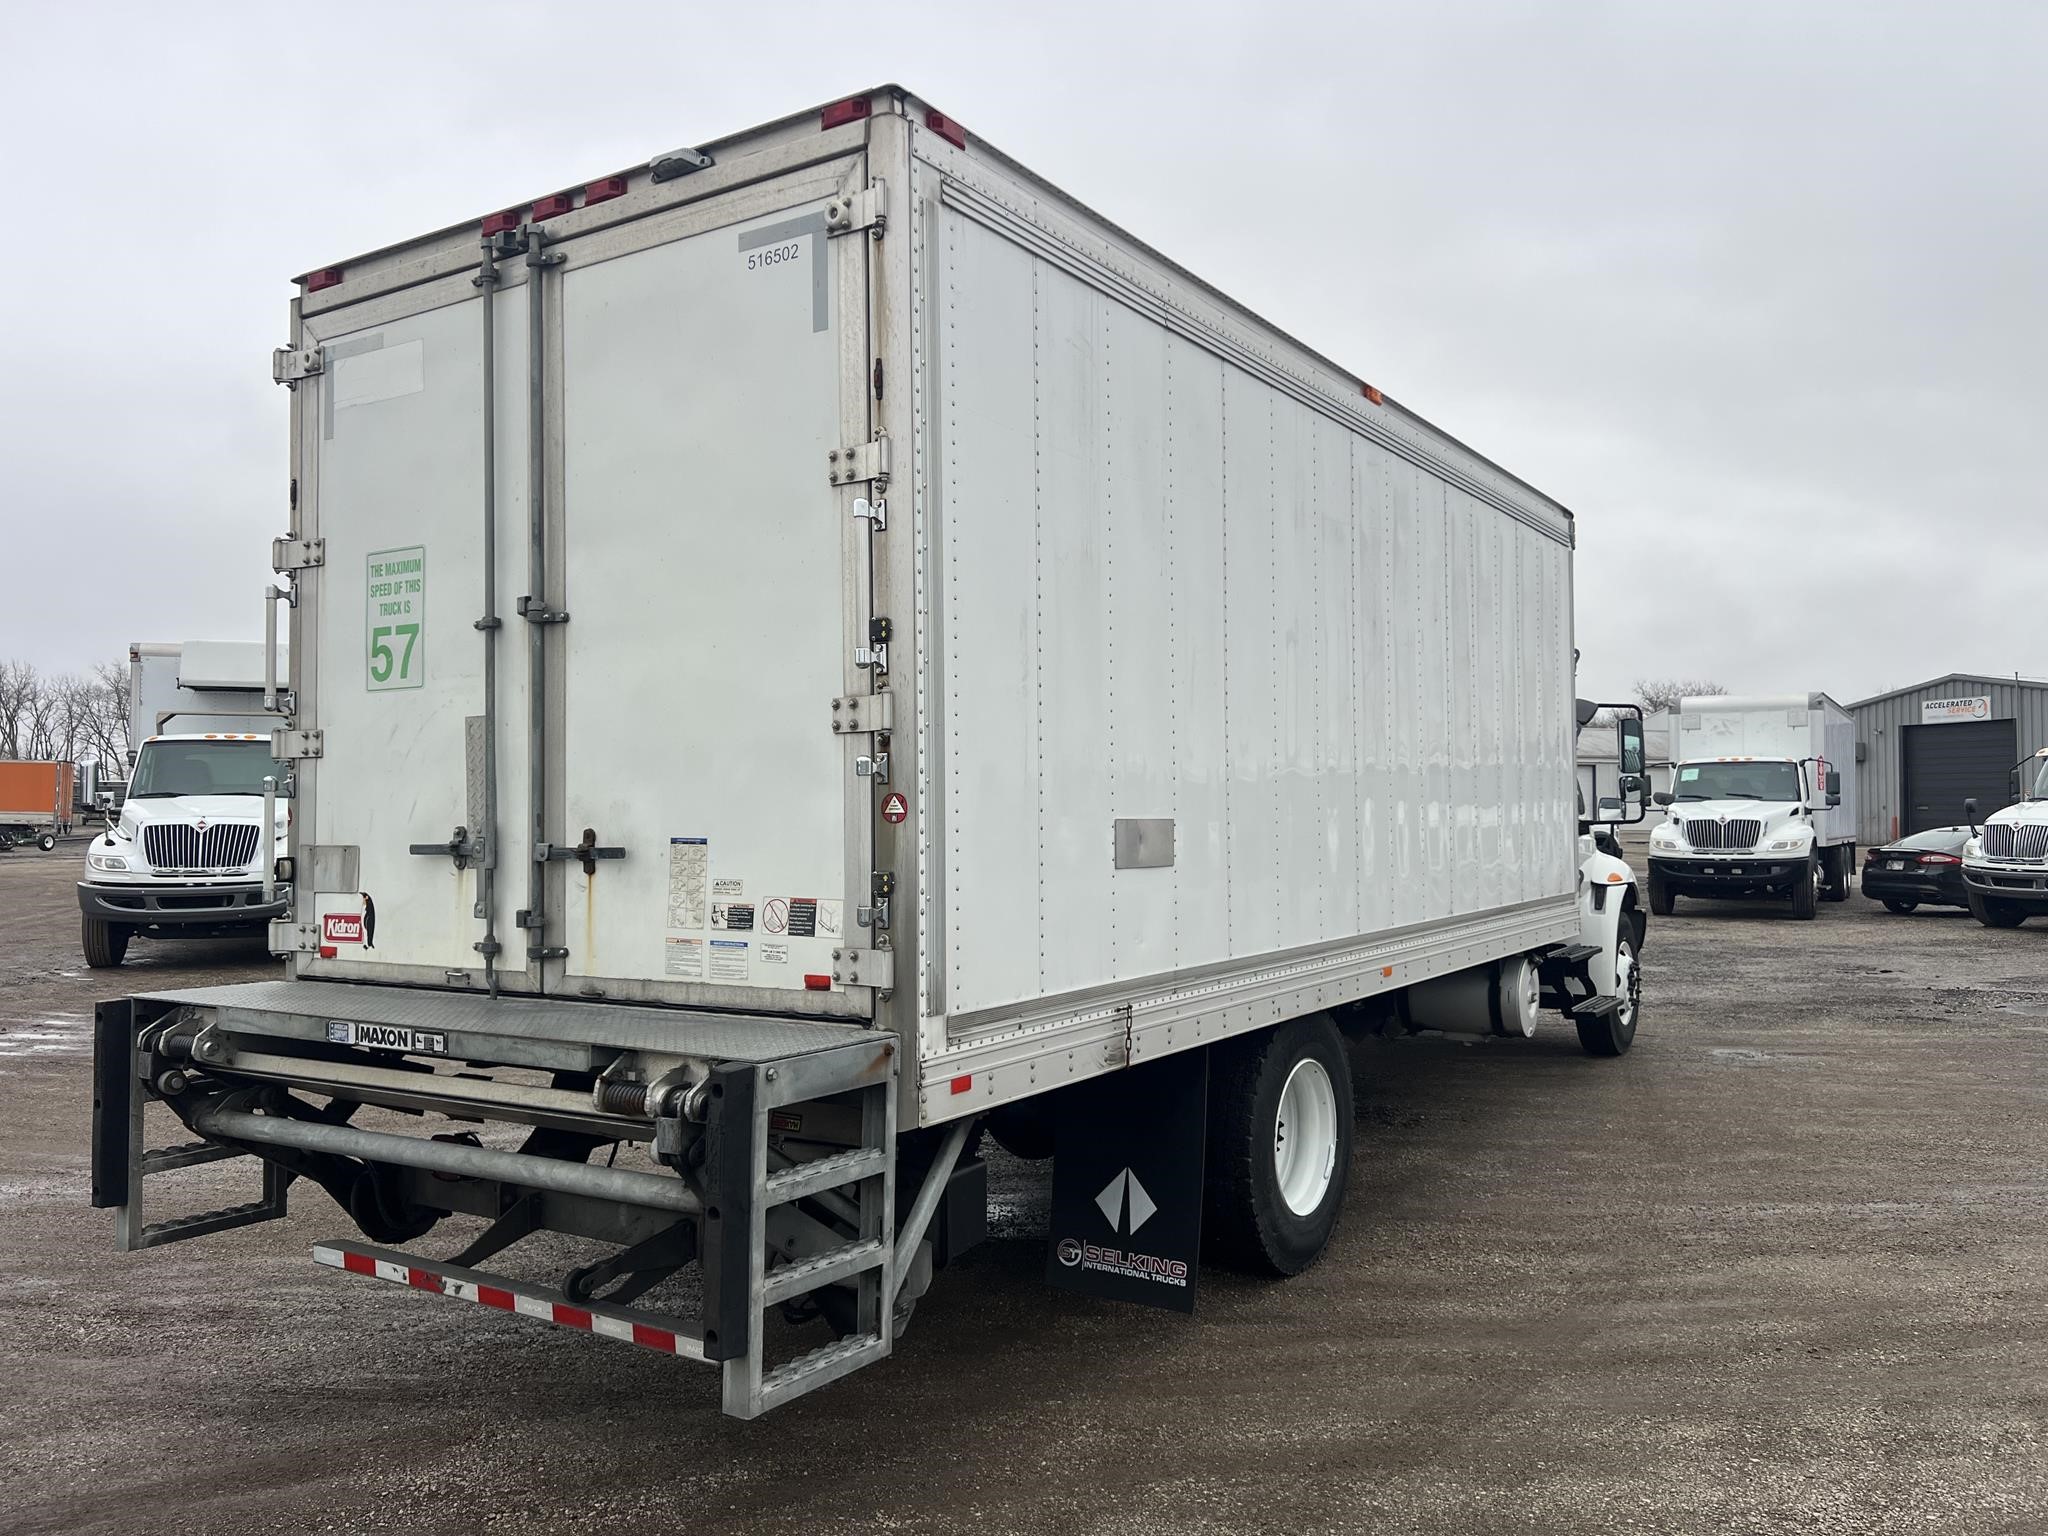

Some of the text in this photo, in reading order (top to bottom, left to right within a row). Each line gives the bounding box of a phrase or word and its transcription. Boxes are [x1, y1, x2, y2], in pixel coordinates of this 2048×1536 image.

[747, 243, 799, 270] 516502
[370, 559, 421, 578] THE MAXIMUM
[370, 578, 421, 598] SPEED OF THIS
[379, 600, 411, 616] TRUCK IS
[370, 623, 420, 682] 57
[1925, 700, 1973, 709] ACCELERATED
[1947, 705, 1977, 714] SERVICE
[326, 918, 360, 937] Kidron
[360, 1026, 409, 1047] MAXON
[1085, 1245, 1187, 1278] SELKING
[1084, 1260, 1187, 1288] INTERNATIONAL TRUCKS
